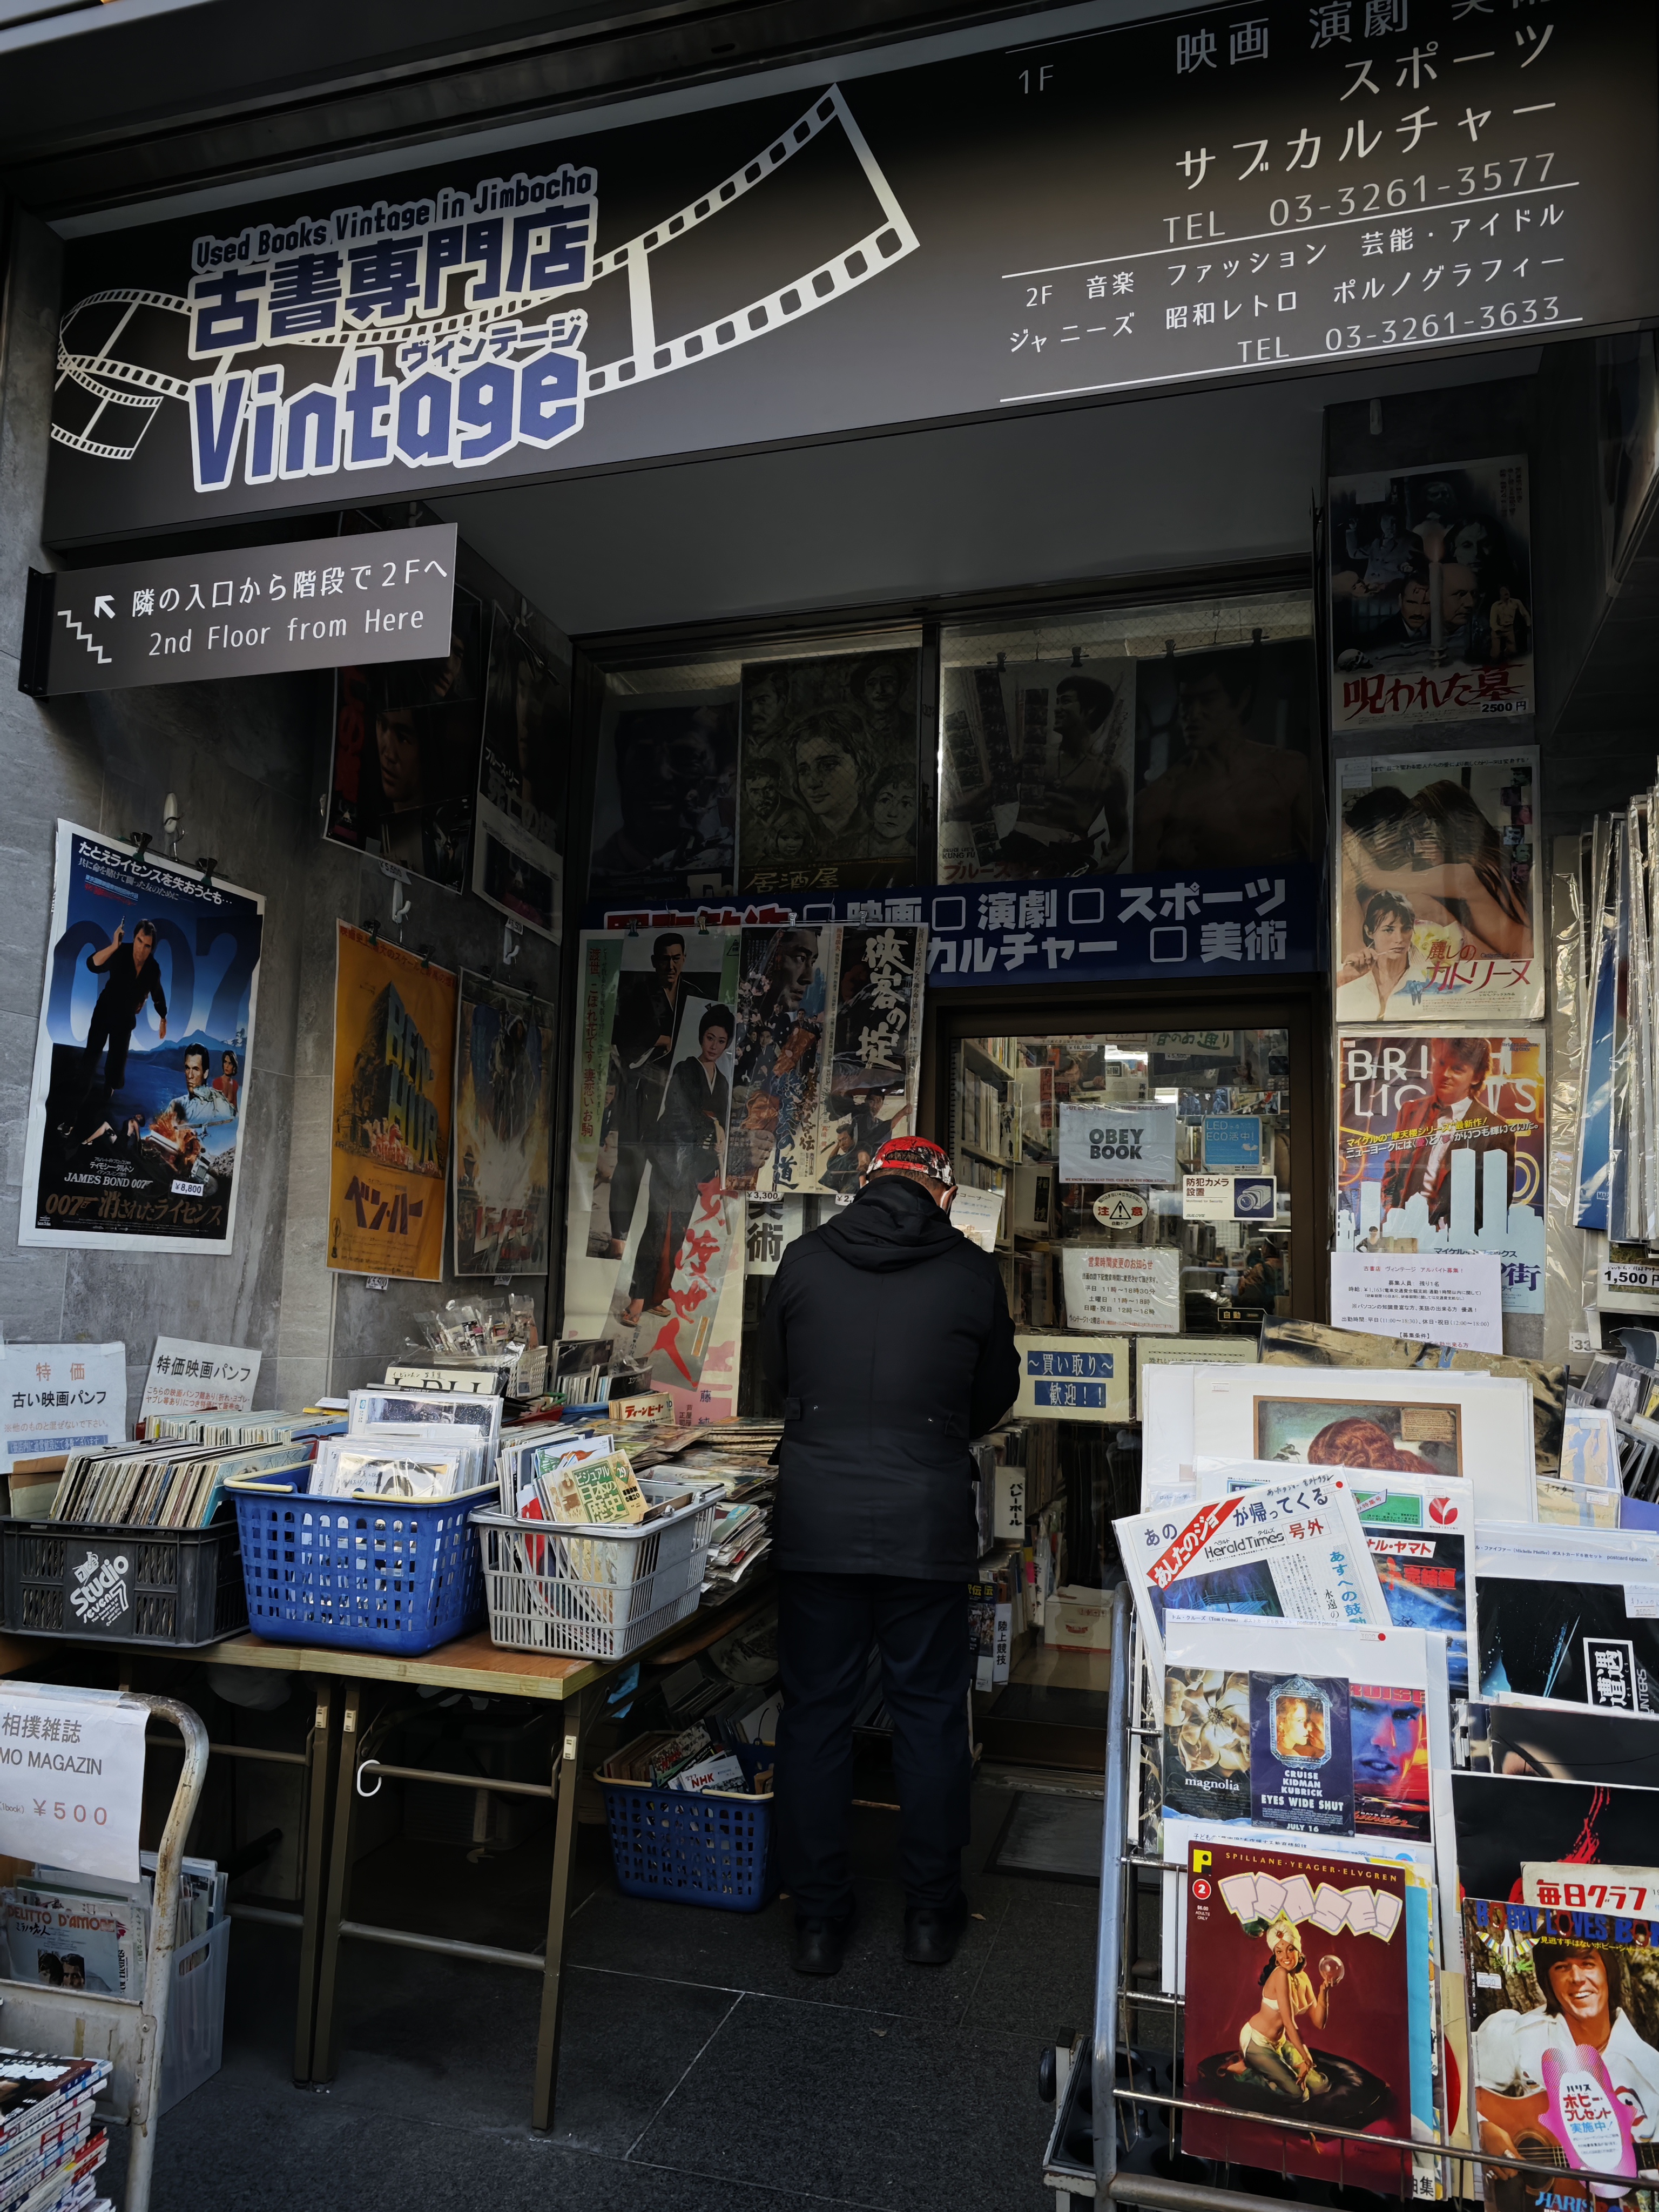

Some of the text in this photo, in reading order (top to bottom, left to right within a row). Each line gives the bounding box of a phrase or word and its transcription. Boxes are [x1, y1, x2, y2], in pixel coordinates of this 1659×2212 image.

[1176, 0, 1407, 74] 映画 演劇
[1340, 25, 1553, 101] スポーツ
[1019, 66, 1053, 95] 1F
[1176, 103, 1556, 190] サブカルチャー
[1163, 153, 1555, 243] TEL 03-3261-3577
[197, 169, 592, 267] Used Books Vintage in Jimbocho
[1027, 204, 1565, 308] 2F 音楽 ファッション 芸能・アイドル
[192, 202, 592, 354] 古書専門店
[1010, 257, 1565, 354] ジャニーズ 昭和レトロ ポルノグラフィー
[401, 315, 583, 370] ヴィンテージ
[1238, 296, 1560, 363] TEL 03-3261-3633
[194, 351, 580, 486] Vintage
[132, 559, 448, 618] 隣の入口から階段で2Fへ
[149, 609, 424, 657] 2nd Floor from Here
[1344, 664, 1527, 721] 呪われた墓
[1482, 703, 1513, 713] 2500
[977, 889, 1057, 930] 演劇
[1117, 878, 1286, 923] スポーツ
[1199, 919, 1287, 963] 美術
[1422, 960, 1533, 994] カトリーヌ
[1089, 1128, 1144, 1145] OBEY
[1206, 1121, 1228, 1130] LED
[1090, 1145, 1143, 1159] BOOK
[64, 1172, 101, 1185] JAMES
[103, 1175, 130, 1188] BOND
[131, 1179, 153, 1189] 007
[174, 1182, 202, 1194] ¥8,800
[1186, 1178, 1230, 1186] 防犯カメラ
[1186, 1188, 1205, 1197] 設置
[45, 1193, 100, 1216] 007
[1097, 1206, 1110, 1216] 注
[1088, 1256, 1154, 1271] 営業時間変更のお知らせ
[1501, 1262, 1542, 1292] 街
[1604, 1270, 1648, 1285] 1,500
[156, 1355, 251, 1382] 特価映画パンフ
[12, 1390, 107, 1410] 古い映画パンフ
[624, 1404, 664, 1419] ティーンビート
[575, 1465, 610, 1485] ビジュアル
[616, 1466, 627, 1479] 29
[580, 1480, 618, 1505] 日本の
[1009, 1482, 1023, 1527] バレーボール
[589, 1493, 627, 1523] 歴史
[1232, 1487, 1328, 1527] が帰ってくる
[1144, 1523, 1178, 1547] あの
[1289, 1518, 1325, 1540] 号外
[1152, 1501, 1228, 1589] あしたのジョー
[1204, 1532, 1285, 1559] Herald Times
[70, 1555, 129, 1617] Studio
[996, 1621, 1008, 1665] 陸上競技
[2, 1712, 82, 1744] 相撲雑誌
[28, 1750, 103, 1776] MAGAZIN
[1284, 1769, 1319, 1780] CRUISE
[691, 1773, 714, 1789] NHK
[1184, 1777, 1240, 1792] magnolia
[1280, 1786, 1323, 1797] KUBRICK
[1282, 1778, 1321, 1789] KIDMAN
[1261, 1794, 1344, 1812] EYES WIDE SHUT
[1286, 1822, 1319, 1832] JULY 16
[1225, 1852, 1398, 1883] SPILLANE YEAGER ELVGREN
[1536, 1879, 1647, 1911] 毎日グラフ
[8, 1905, 52, 1925] DELITTO
[1476, 1900, 1608, 1941] BOBBY LOVES
[1566, 2083, 1592, 2093] ハリス
[1564, 2107, 1612, 2122] プレゼント
